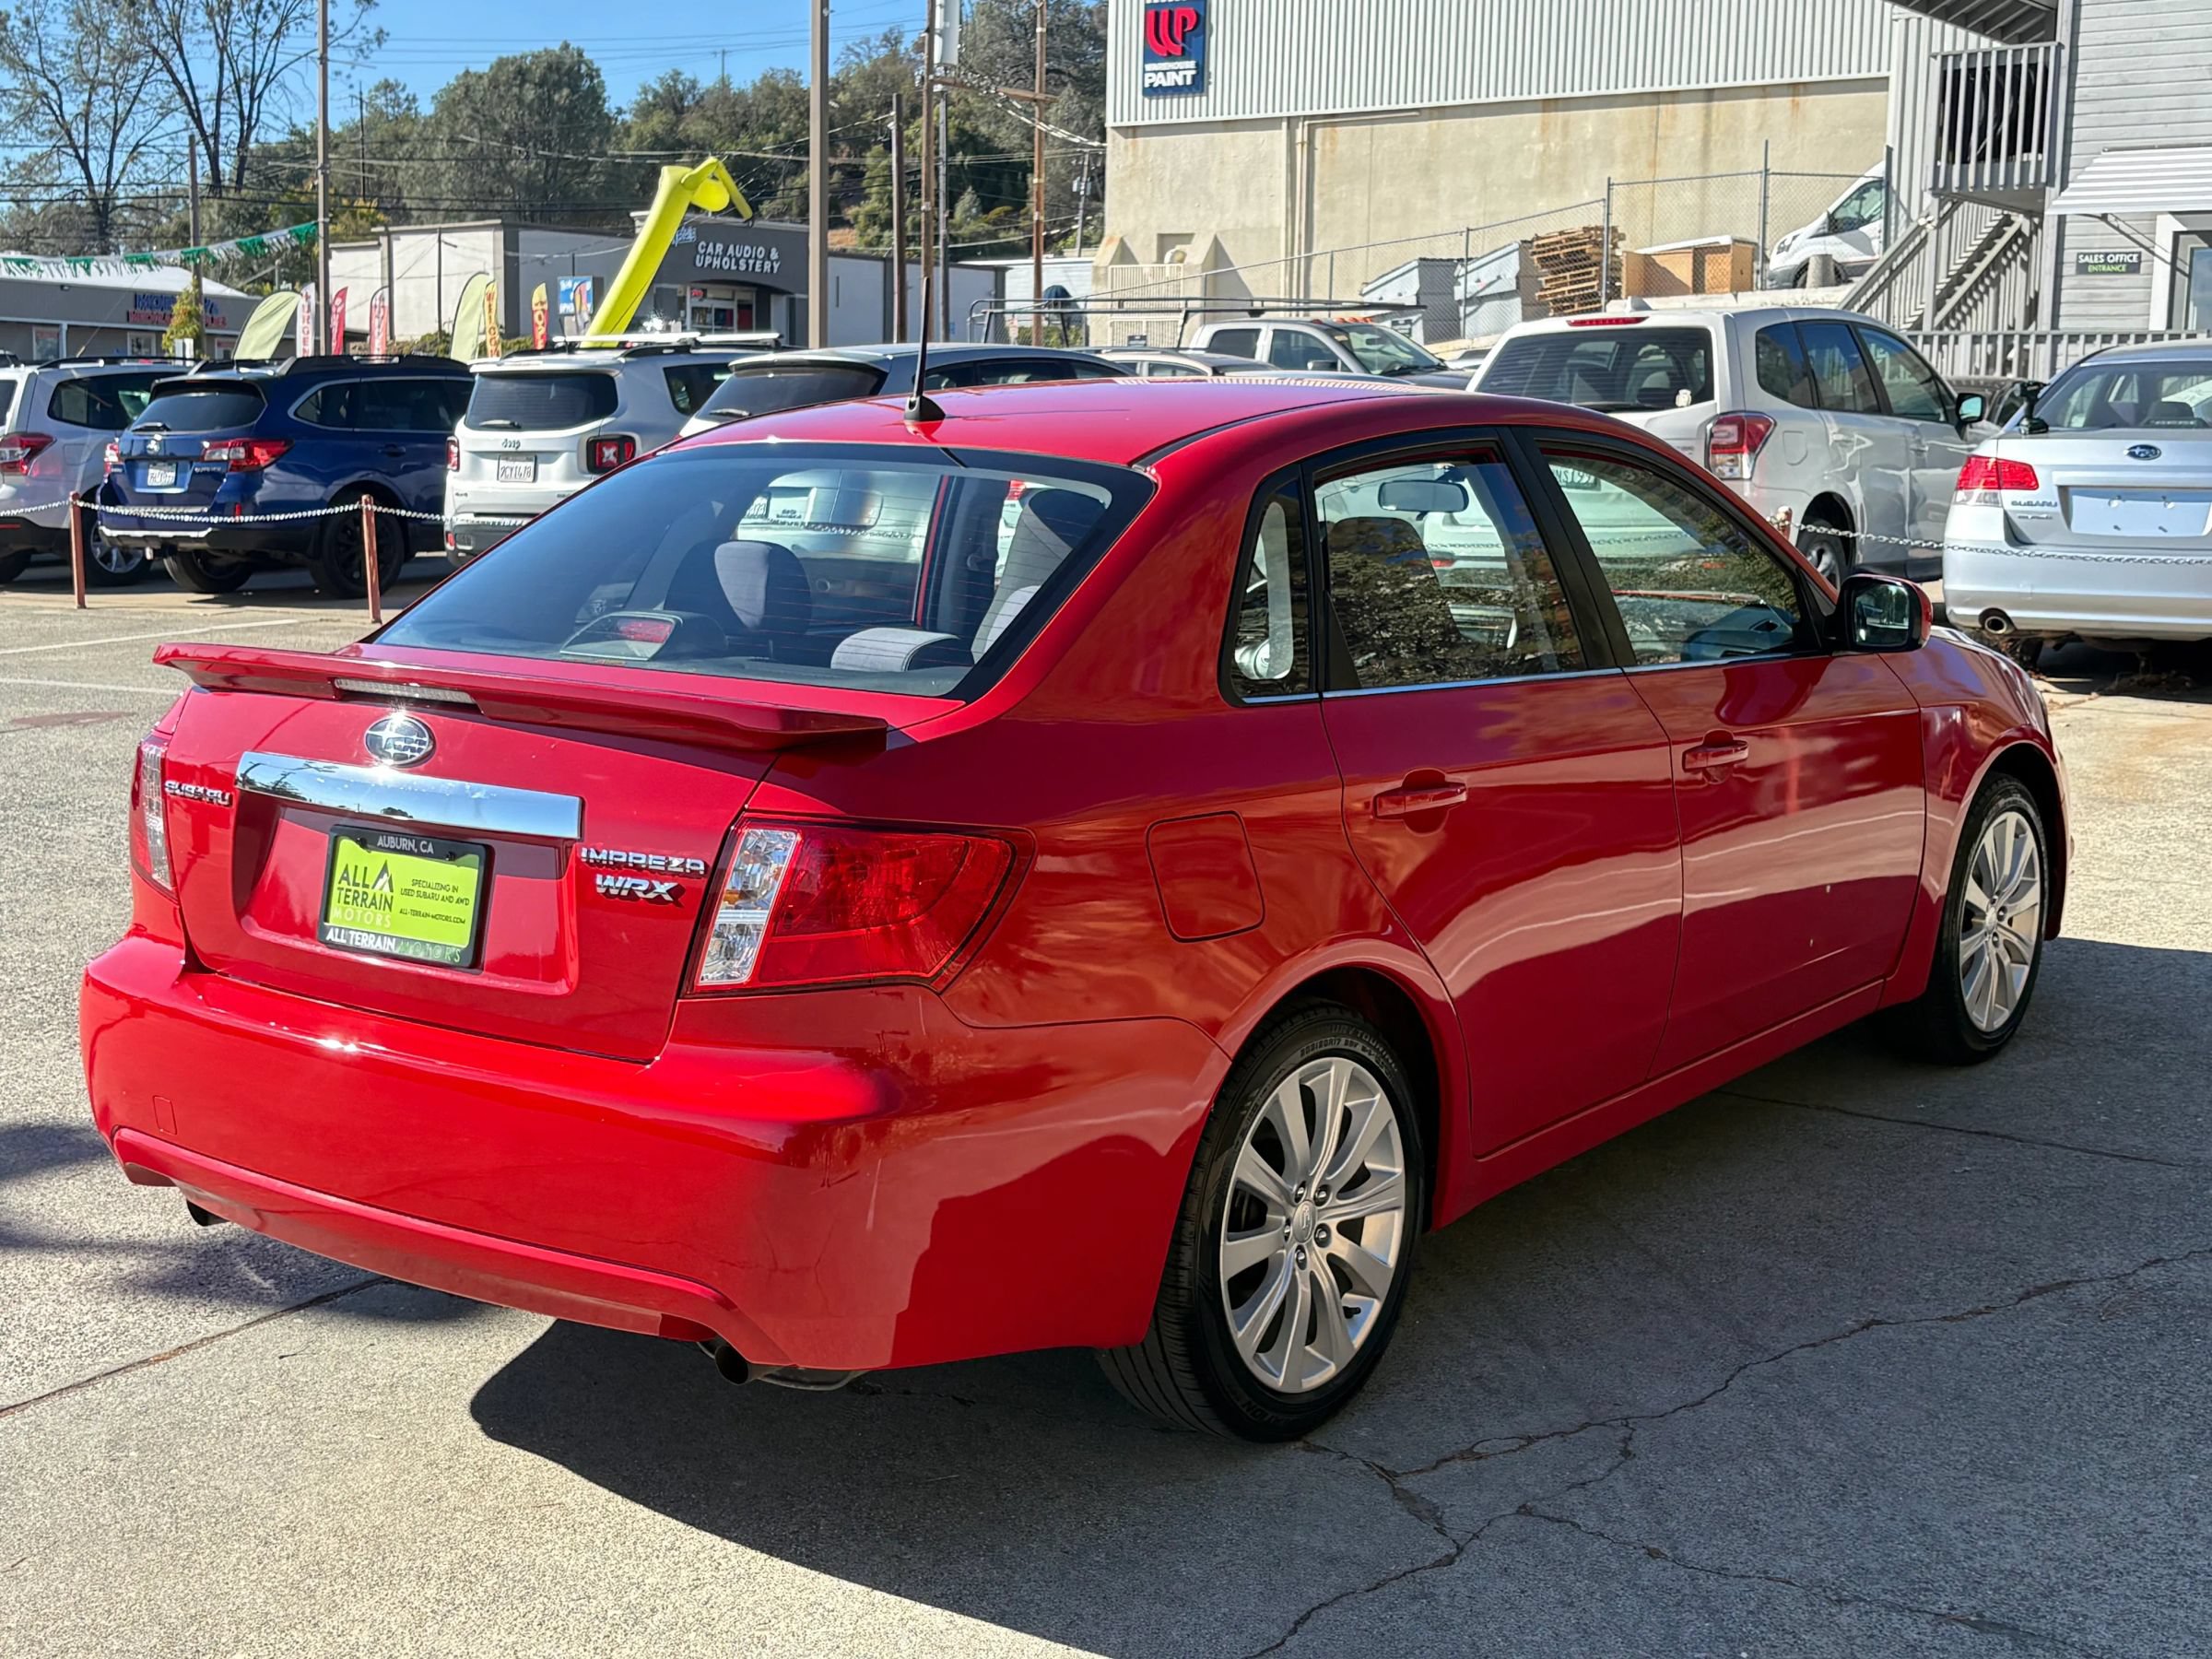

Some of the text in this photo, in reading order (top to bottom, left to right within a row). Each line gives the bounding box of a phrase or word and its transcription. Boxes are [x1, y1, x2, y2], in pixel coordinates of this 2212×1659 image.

[1144, 70, 1197, 88] PAINT
[698, 241, 780, 260] CAR AUDIO &
[2078, 253, 2138, 264] SALES OFFICE
[695, 254, 781, 274] UPHOLSTERY
[2088, 264, 2127, 273] ENTRANCE
[164, 781, 231, 806] SUBARU
[377, 835, 434, 854] AUBURN, CA
[581, 846, 705, 875] IMPREZA
[338, 863, 370, 889] ALL
[411, 878, 459, 893] SPECIALIZING IN
[400, 888, 470, 906] USED SUBARU AND AWD
[595, 874, 679, 901] WRX
[337, 887, 394, 912] TERRAIN
[332, 907, 392, 928] MOTORS
[325, 927, 347, 943] ALL
[348, 930, 396, 952] TERRAIN
